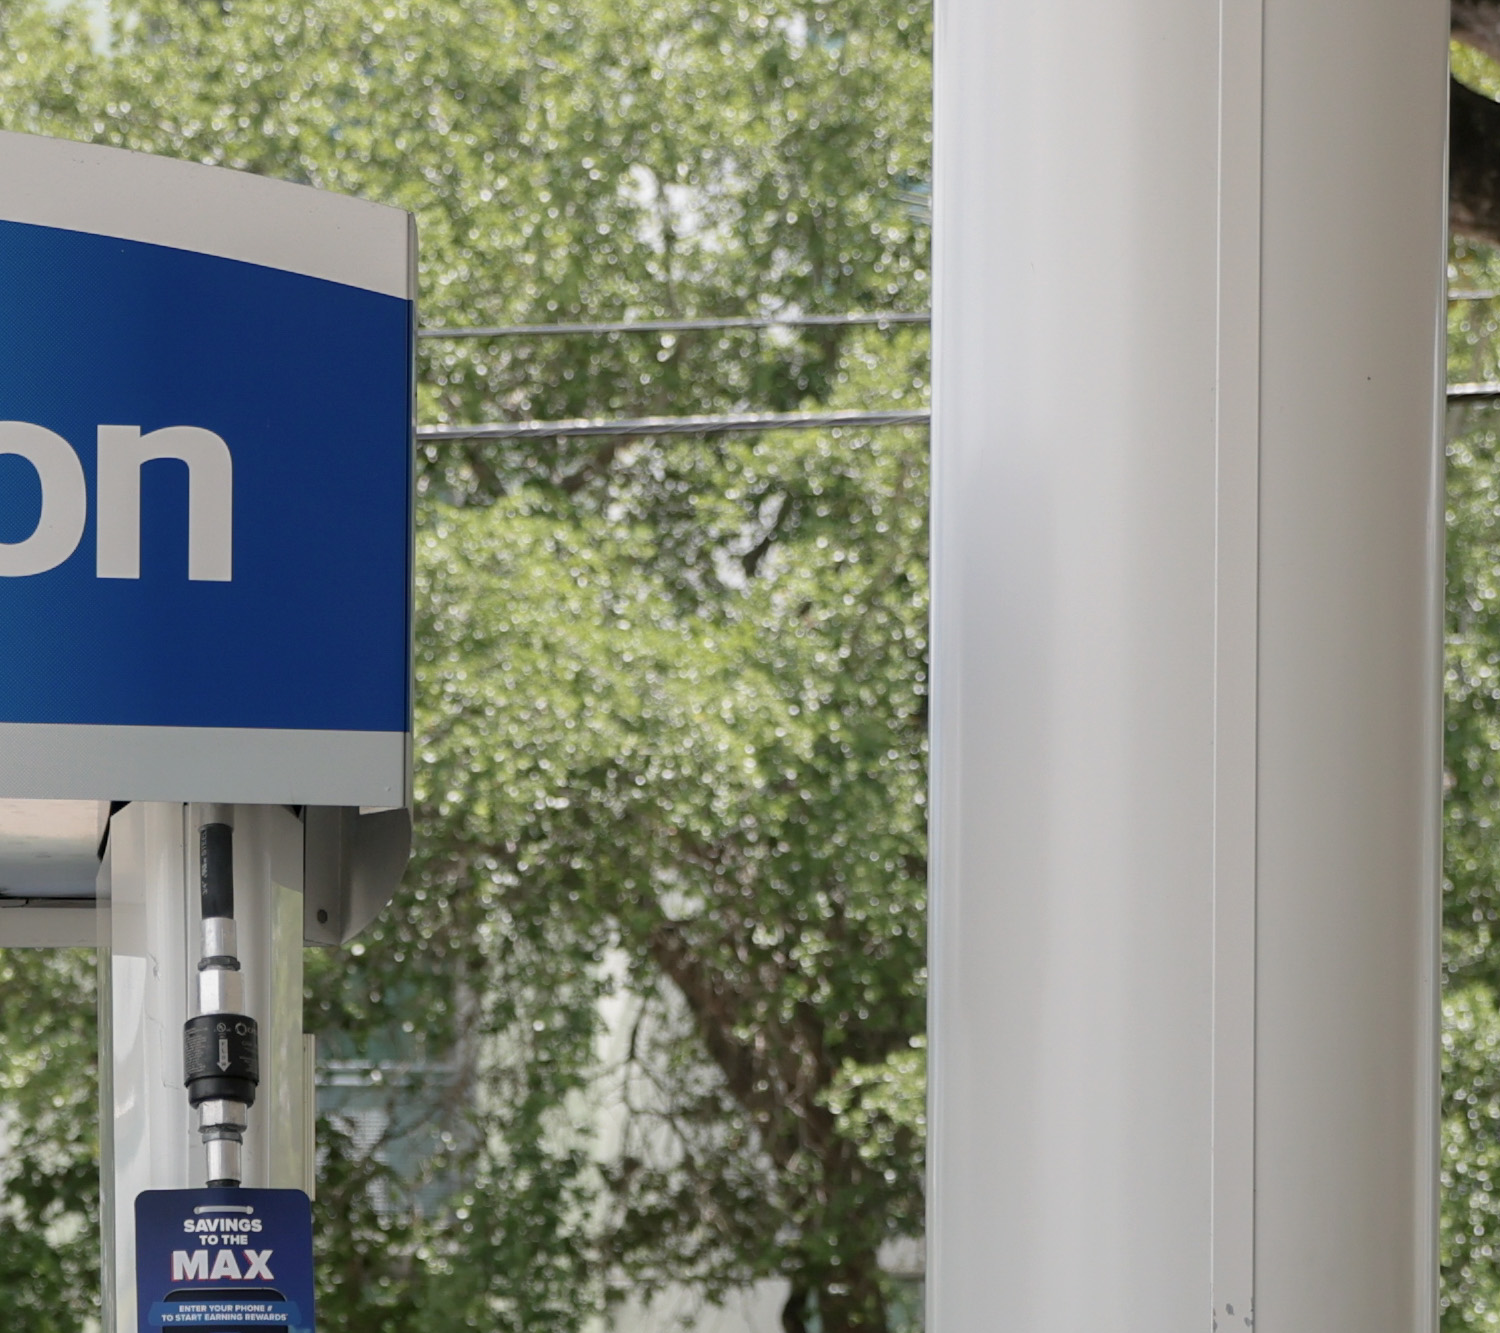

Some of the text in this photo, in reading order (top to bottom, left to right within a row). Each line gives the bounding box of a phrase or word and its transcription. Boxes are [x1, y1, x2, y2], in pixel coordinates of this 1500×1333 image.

[184, 1218, 262, 1233] SAVINGS
[199, 1234, 248, 1245] TO THE
[172, 1249, 274, 1280] MAX
[161, 1314, 174, 1322] TO
[175, 1313, 202, 1321] START
[204, 1313, 243, 1321] EARNING
